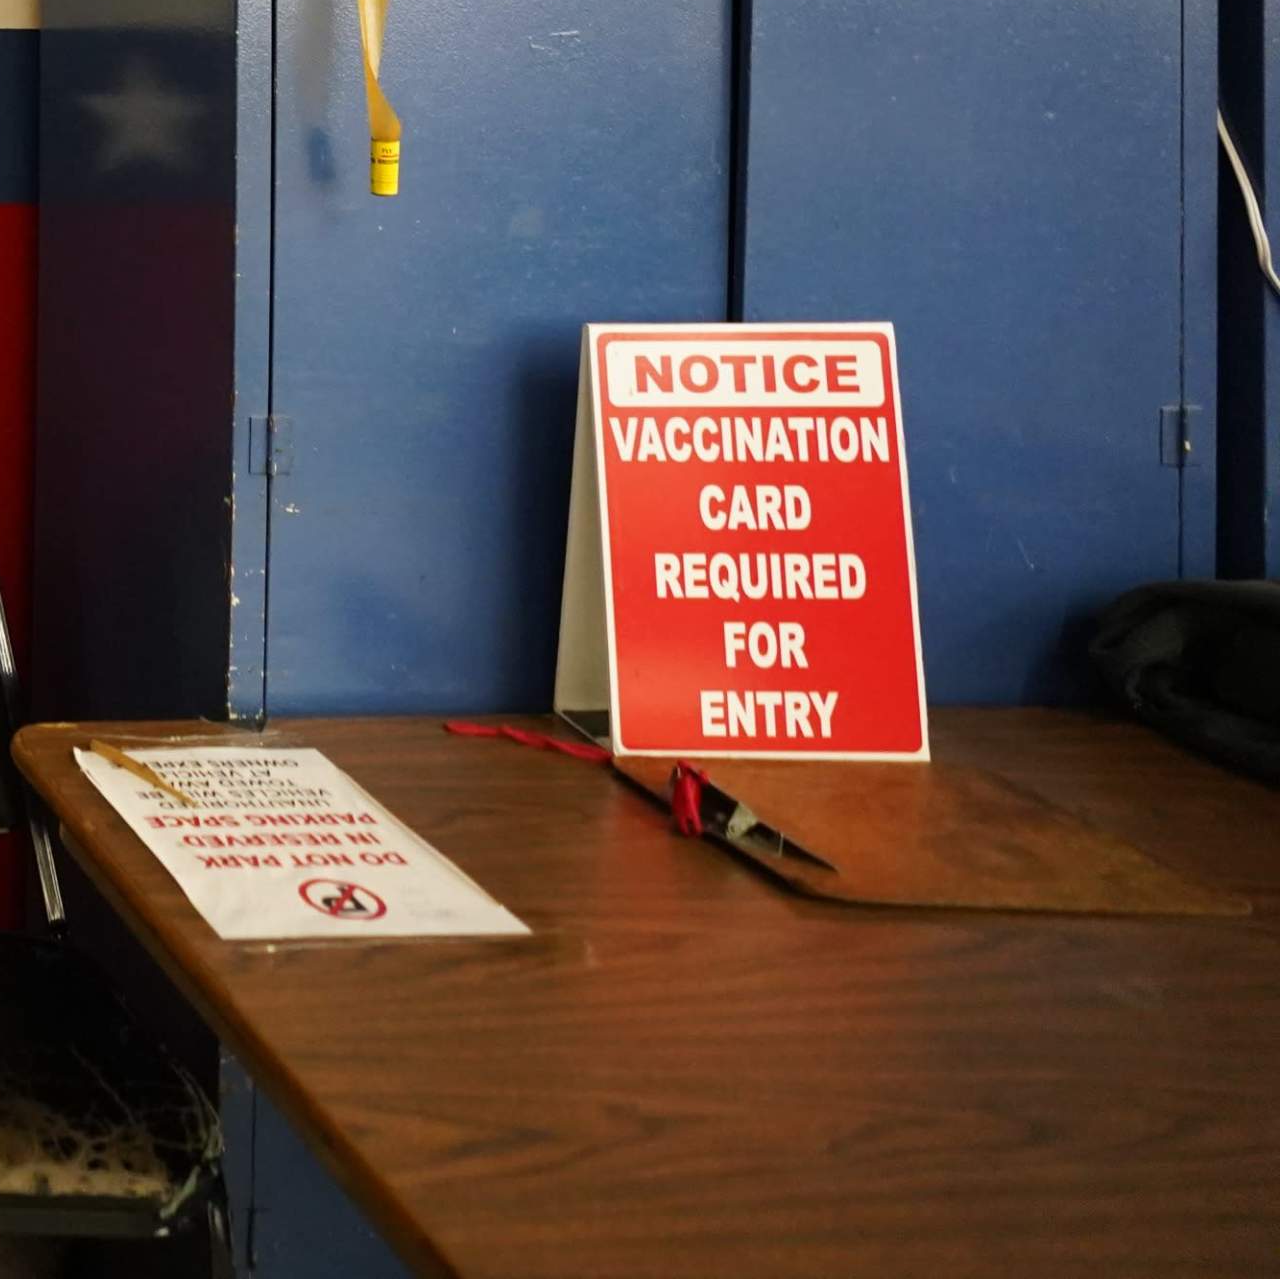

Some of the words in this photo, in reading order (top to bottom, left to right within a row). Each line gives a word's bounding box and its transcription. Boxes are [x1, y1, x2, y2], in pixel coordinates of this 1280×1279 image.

[634, 355, 860, 393] NOTICE
[609, 416, 890, 463] VACCINATION
[699, 484, 811, 531] CARD
[654, 552, 867, 601] REQUIRED
[724, 621, 808, 669] FOR
[700, 690, 838, 738] ENTRY
[207, 759, 299, 768] OWNERS
[248, 769, 272, 777] AT
[218, 778, 298, 787] TOWED
[137, 790, 164, 799] BE
[228, 789, 333, 798] VEHICLES
[145, 813, 240, 828] SPACE
[245, 813, 378, 826] PARKING
[181, 832, 343, 847] RESERVED
[345, 832, 382, 845] IN
[196, 853, 282, 868] PARK
[291, 852, 355, 866] NOT
[360, 852, 408, 865] DO
